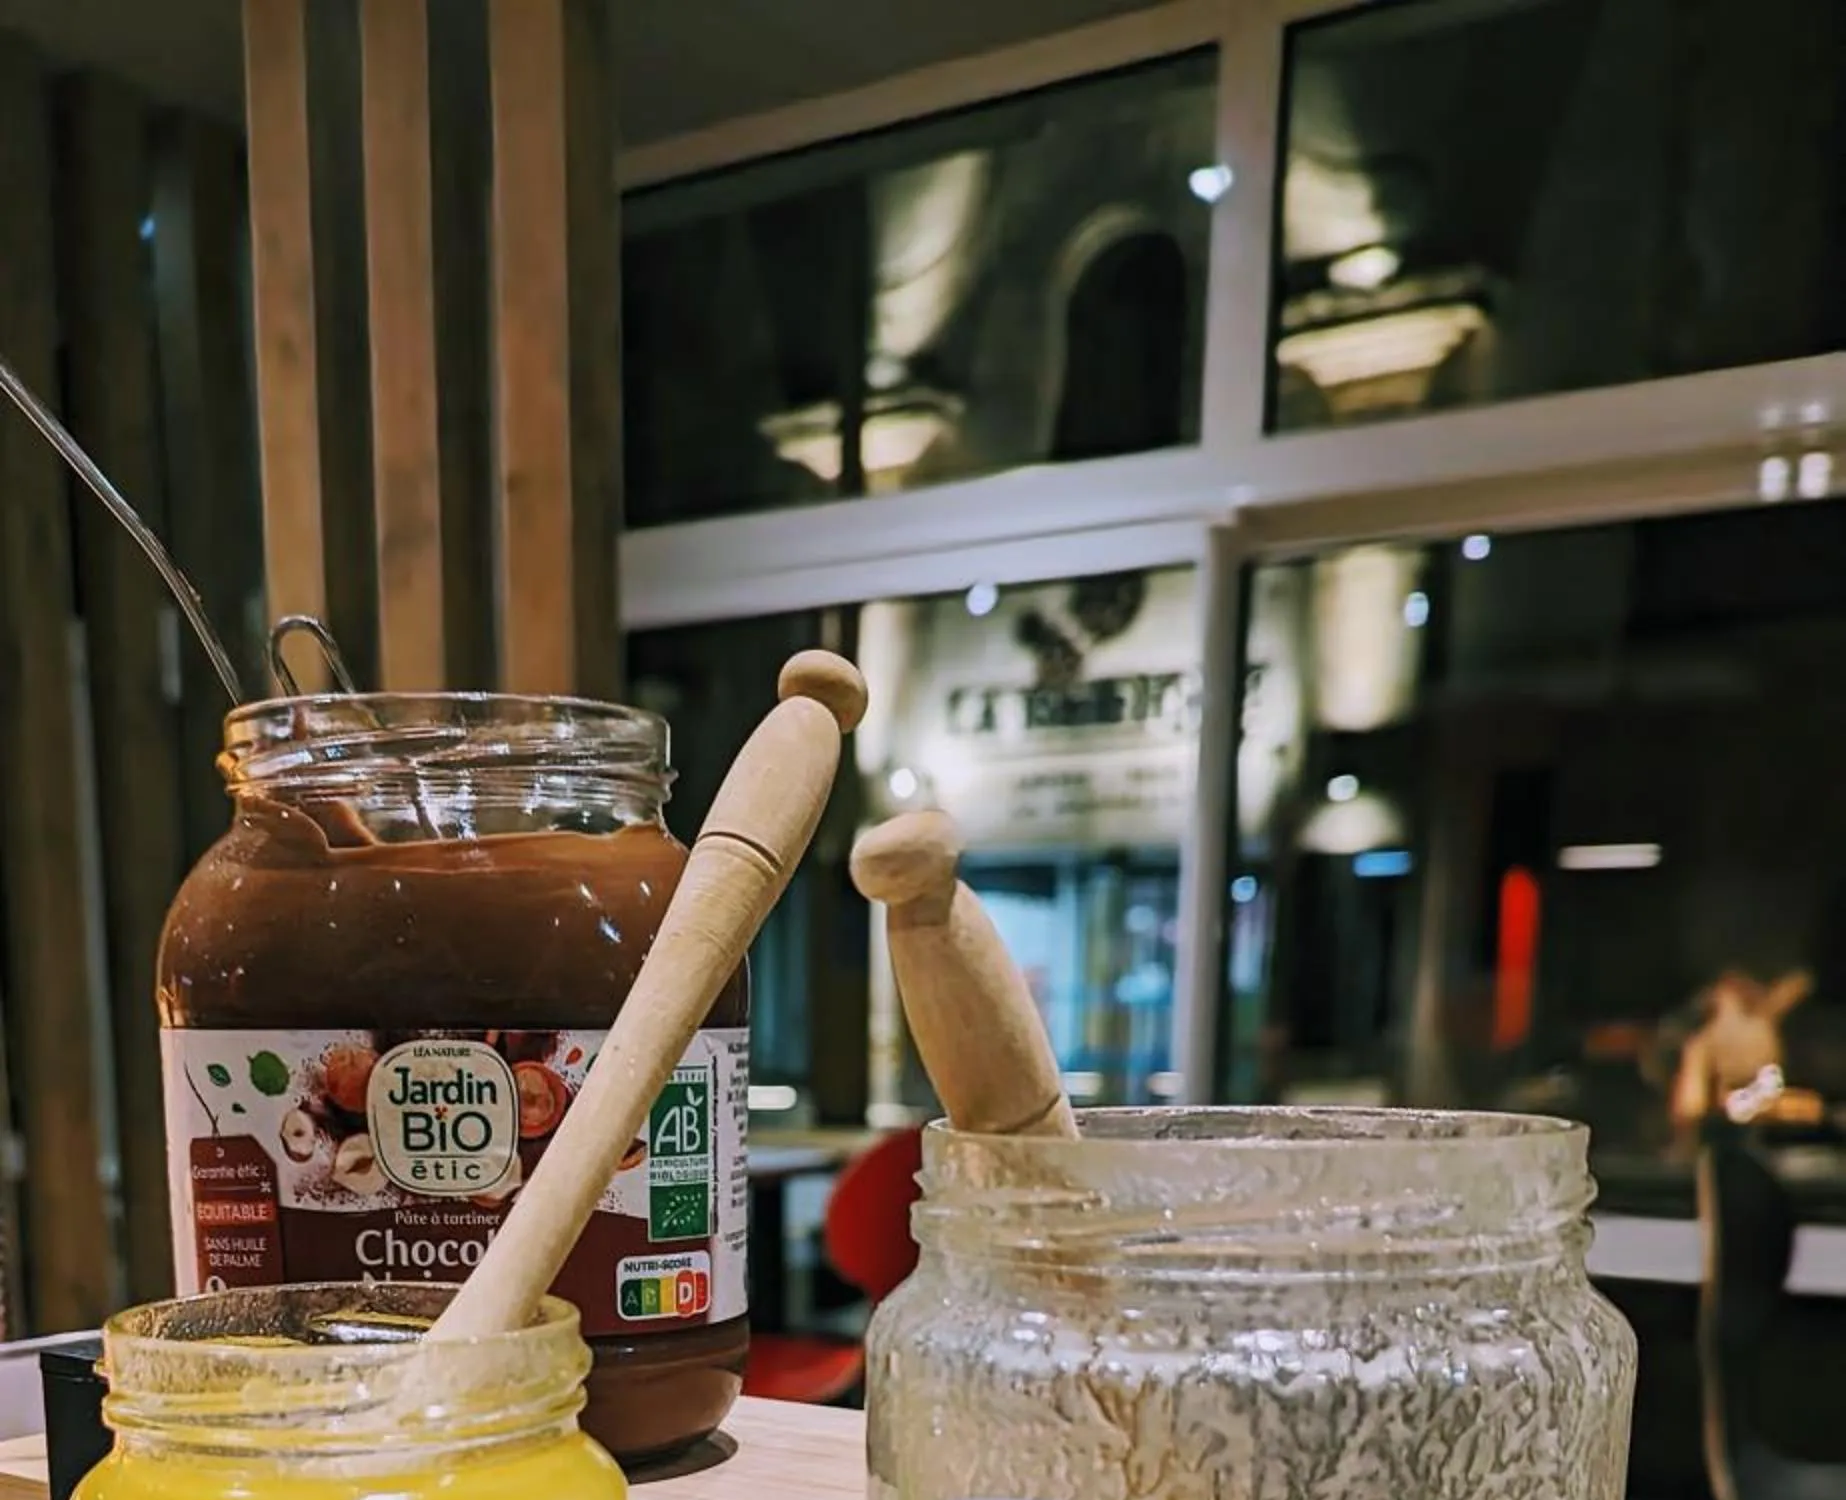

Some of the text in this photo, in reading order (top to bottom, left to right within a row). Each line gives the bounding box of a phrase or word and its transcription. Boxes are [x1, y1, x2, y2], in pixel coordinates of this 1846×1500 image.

[388, 1066, 498, 1105] Jardin
[654, 1105, 700, 1153] AB
[394, 1210, 501, 1225] Pâte à tartiner
